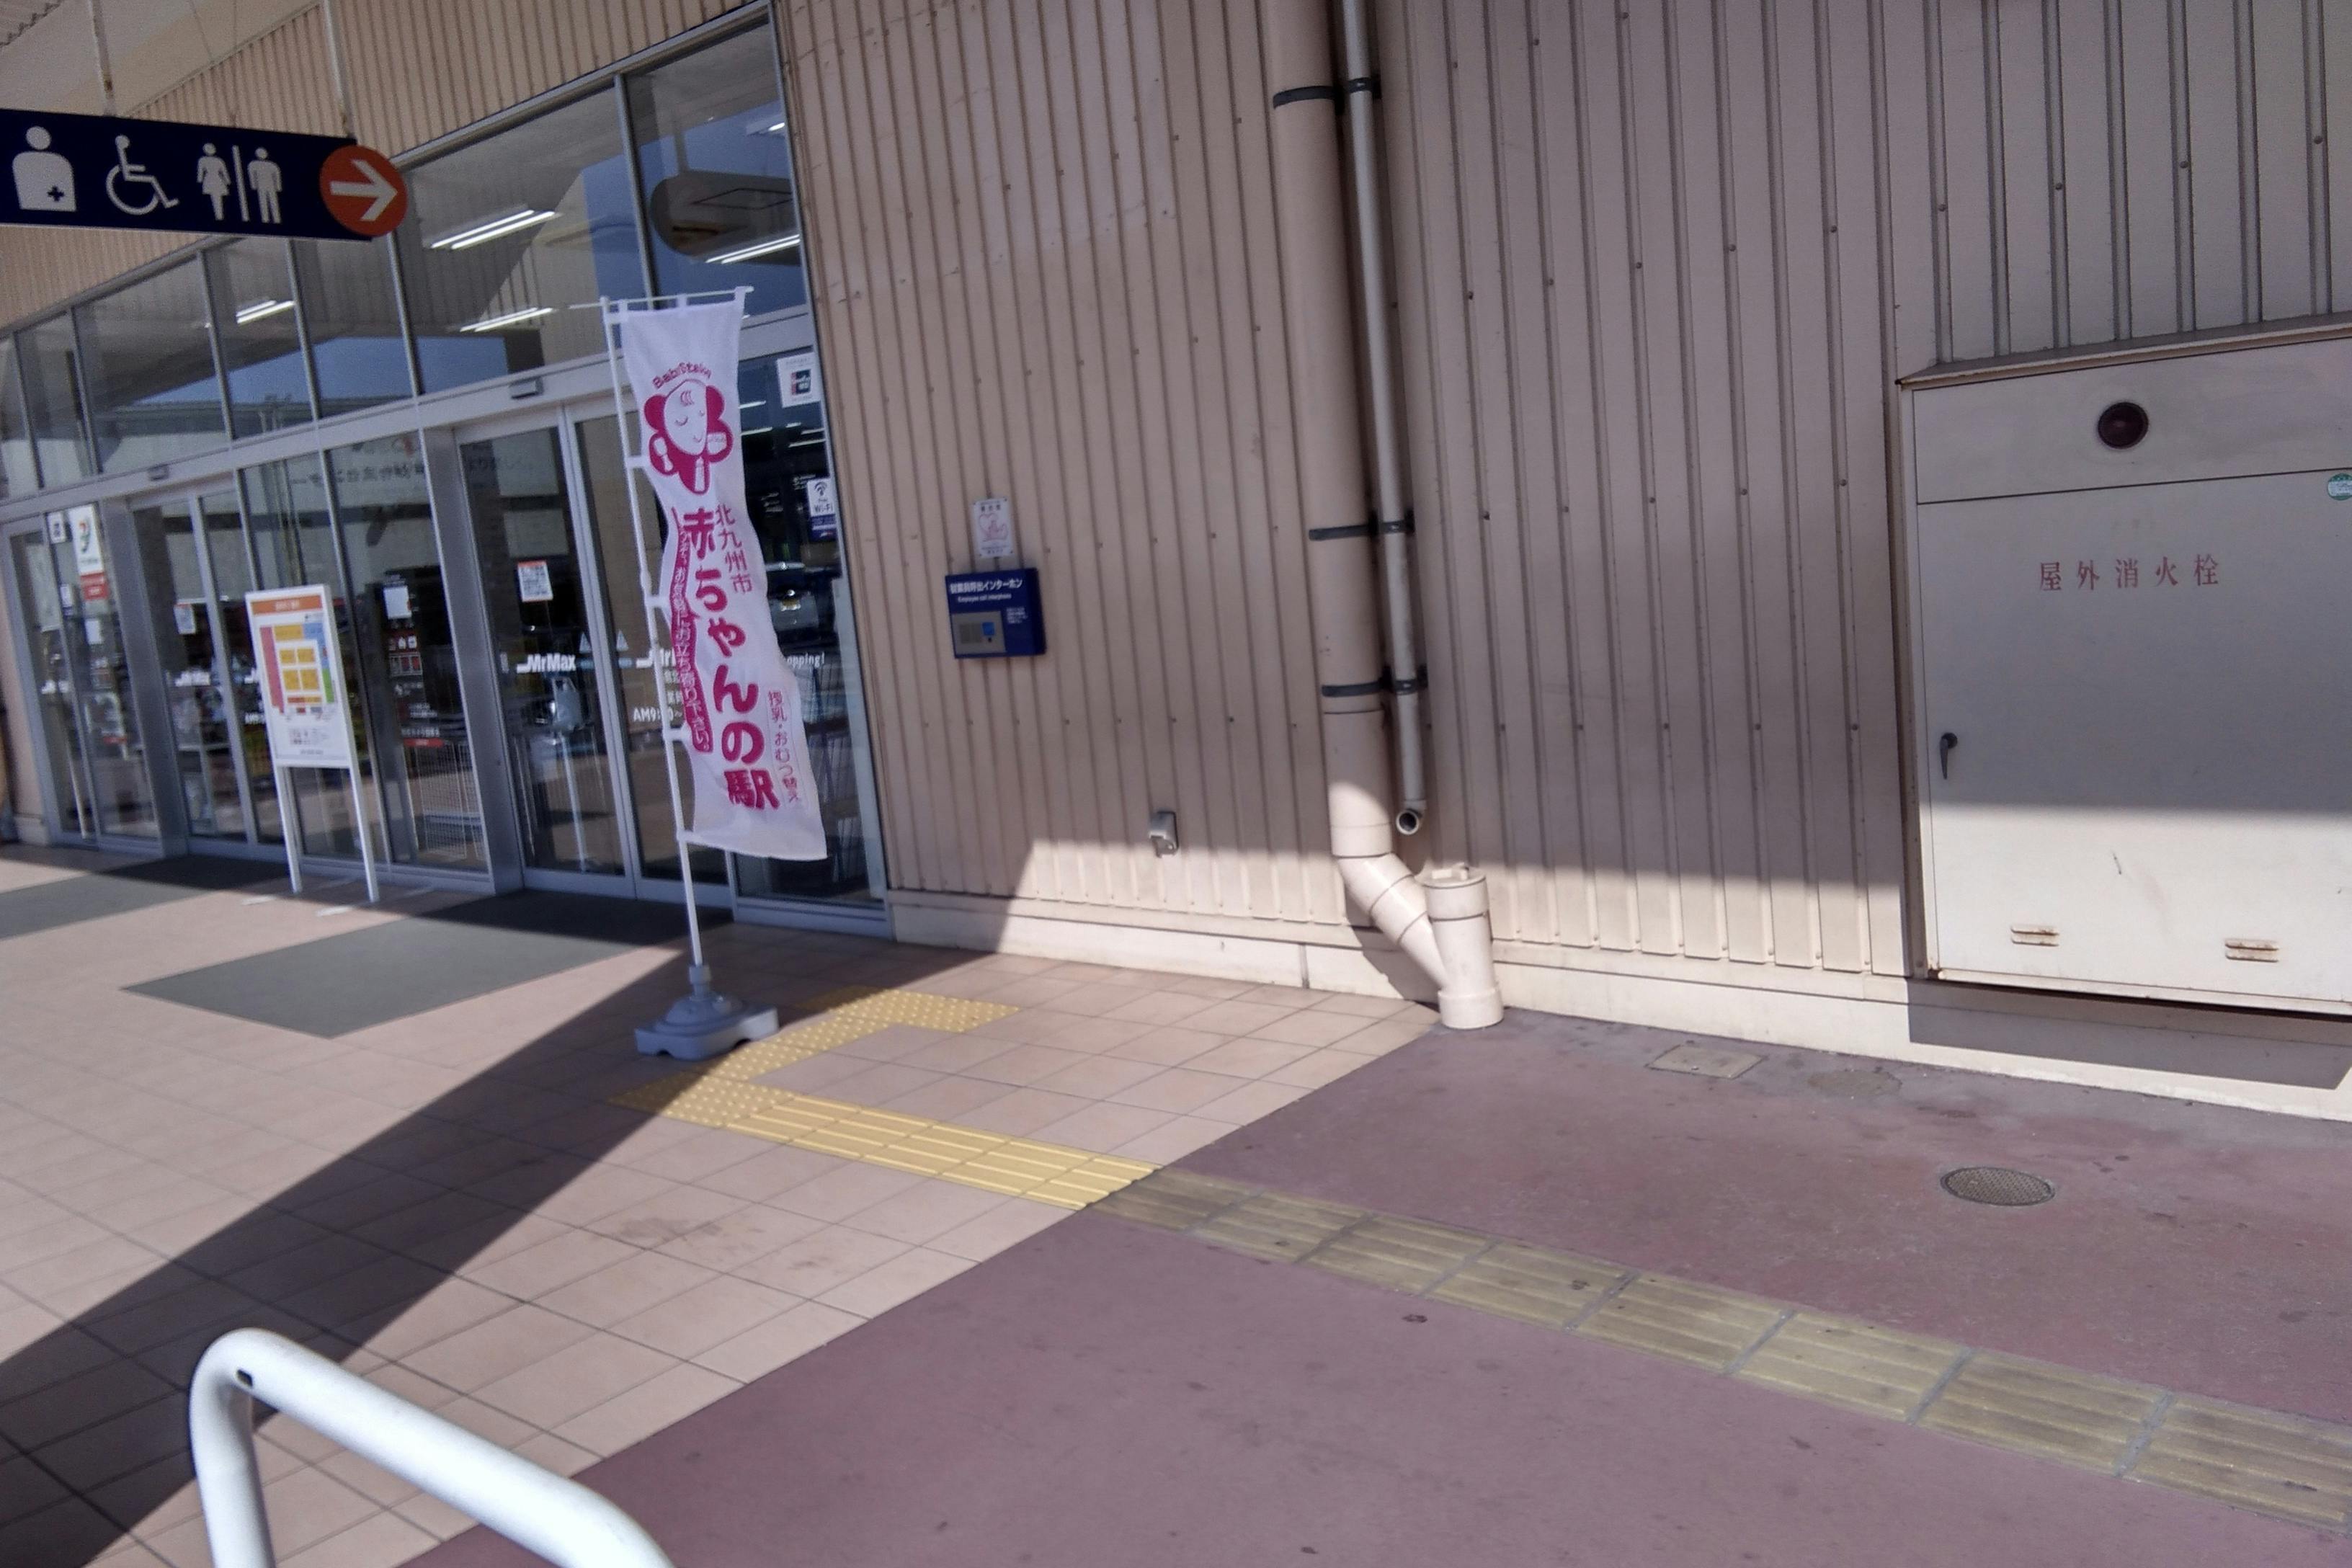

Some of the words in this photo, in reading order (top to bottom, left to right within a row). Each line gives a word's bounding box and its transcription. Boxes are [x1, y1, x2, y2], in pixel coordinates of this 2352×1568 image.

[814, 504, 833, 513] Wi-Fi
[716, 504, 753, 594] 北九州市
[2039, 554, 2219, 591] 屋外消火栓
[517, 652, 576, 673] MrMax
[682, 507, 780, 811] 赤ちゃんの駅
[785, 651, 825, 669] opping!
